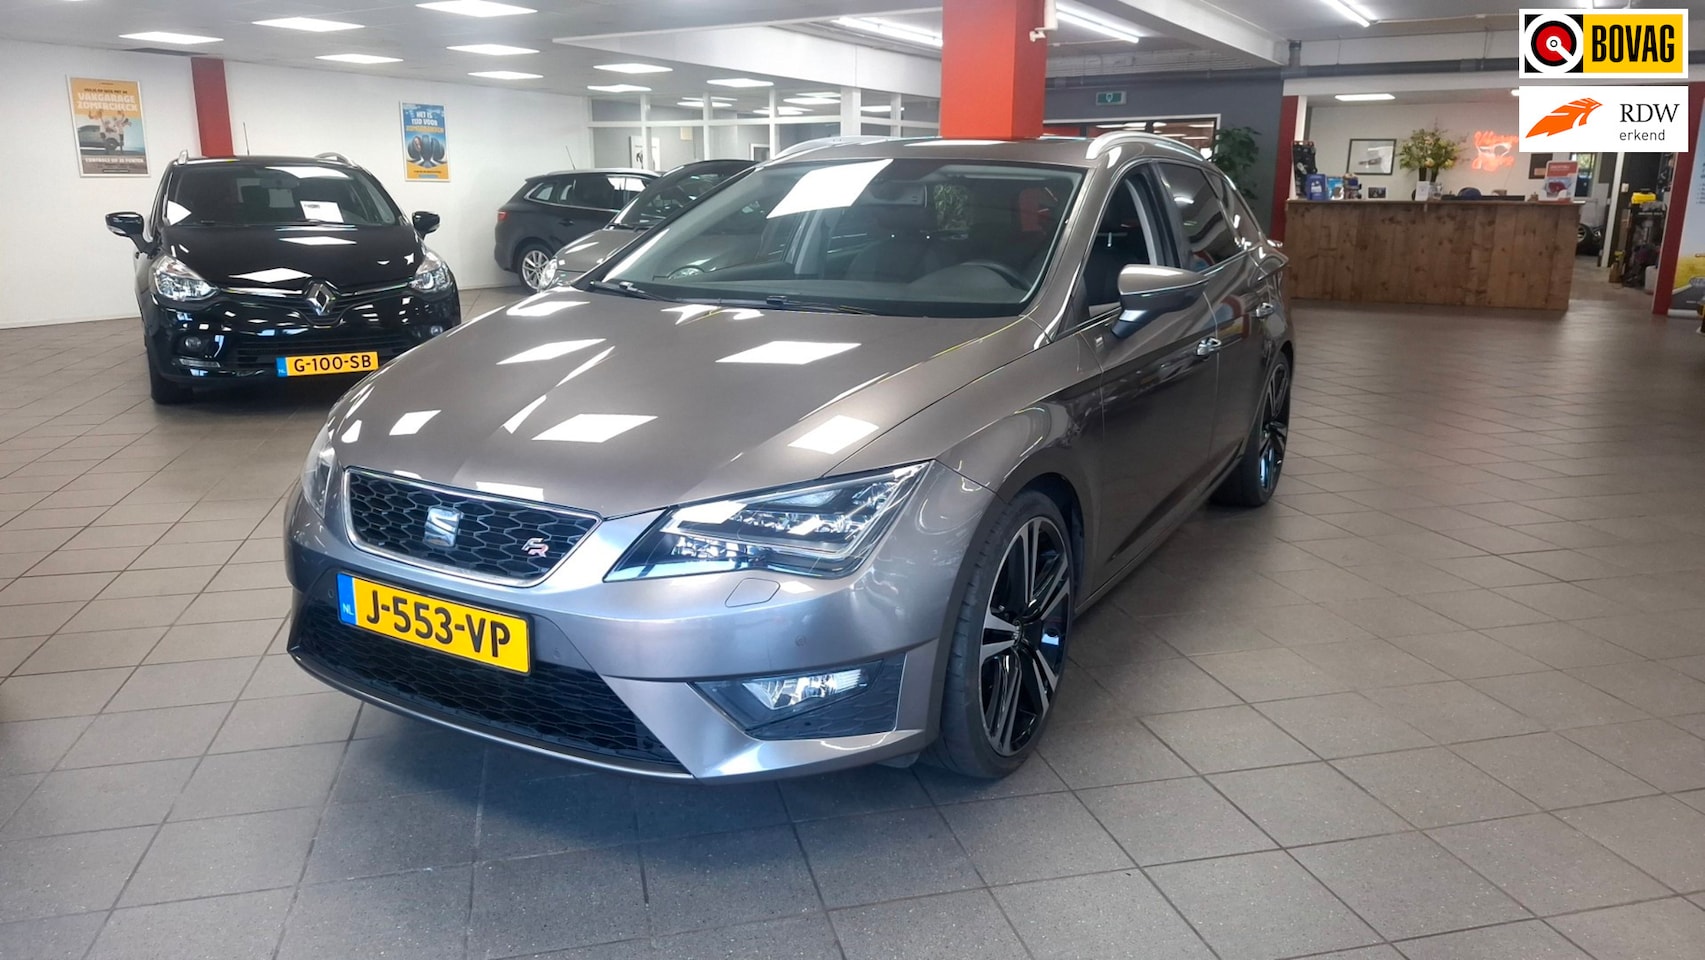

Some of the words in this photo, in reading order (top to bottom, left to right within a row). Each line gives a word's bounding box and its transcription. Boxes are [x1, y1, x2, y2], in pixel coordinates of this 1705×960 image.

[78, 93, 135, 103] VAKGARAGE
[77, 101, 138, 112] ZOMERCHECK
[294, 354, 372, 372] G-100-SB
[342, 604, 355, 616] NL
[366, 590, 511, 658] J-553-VP
